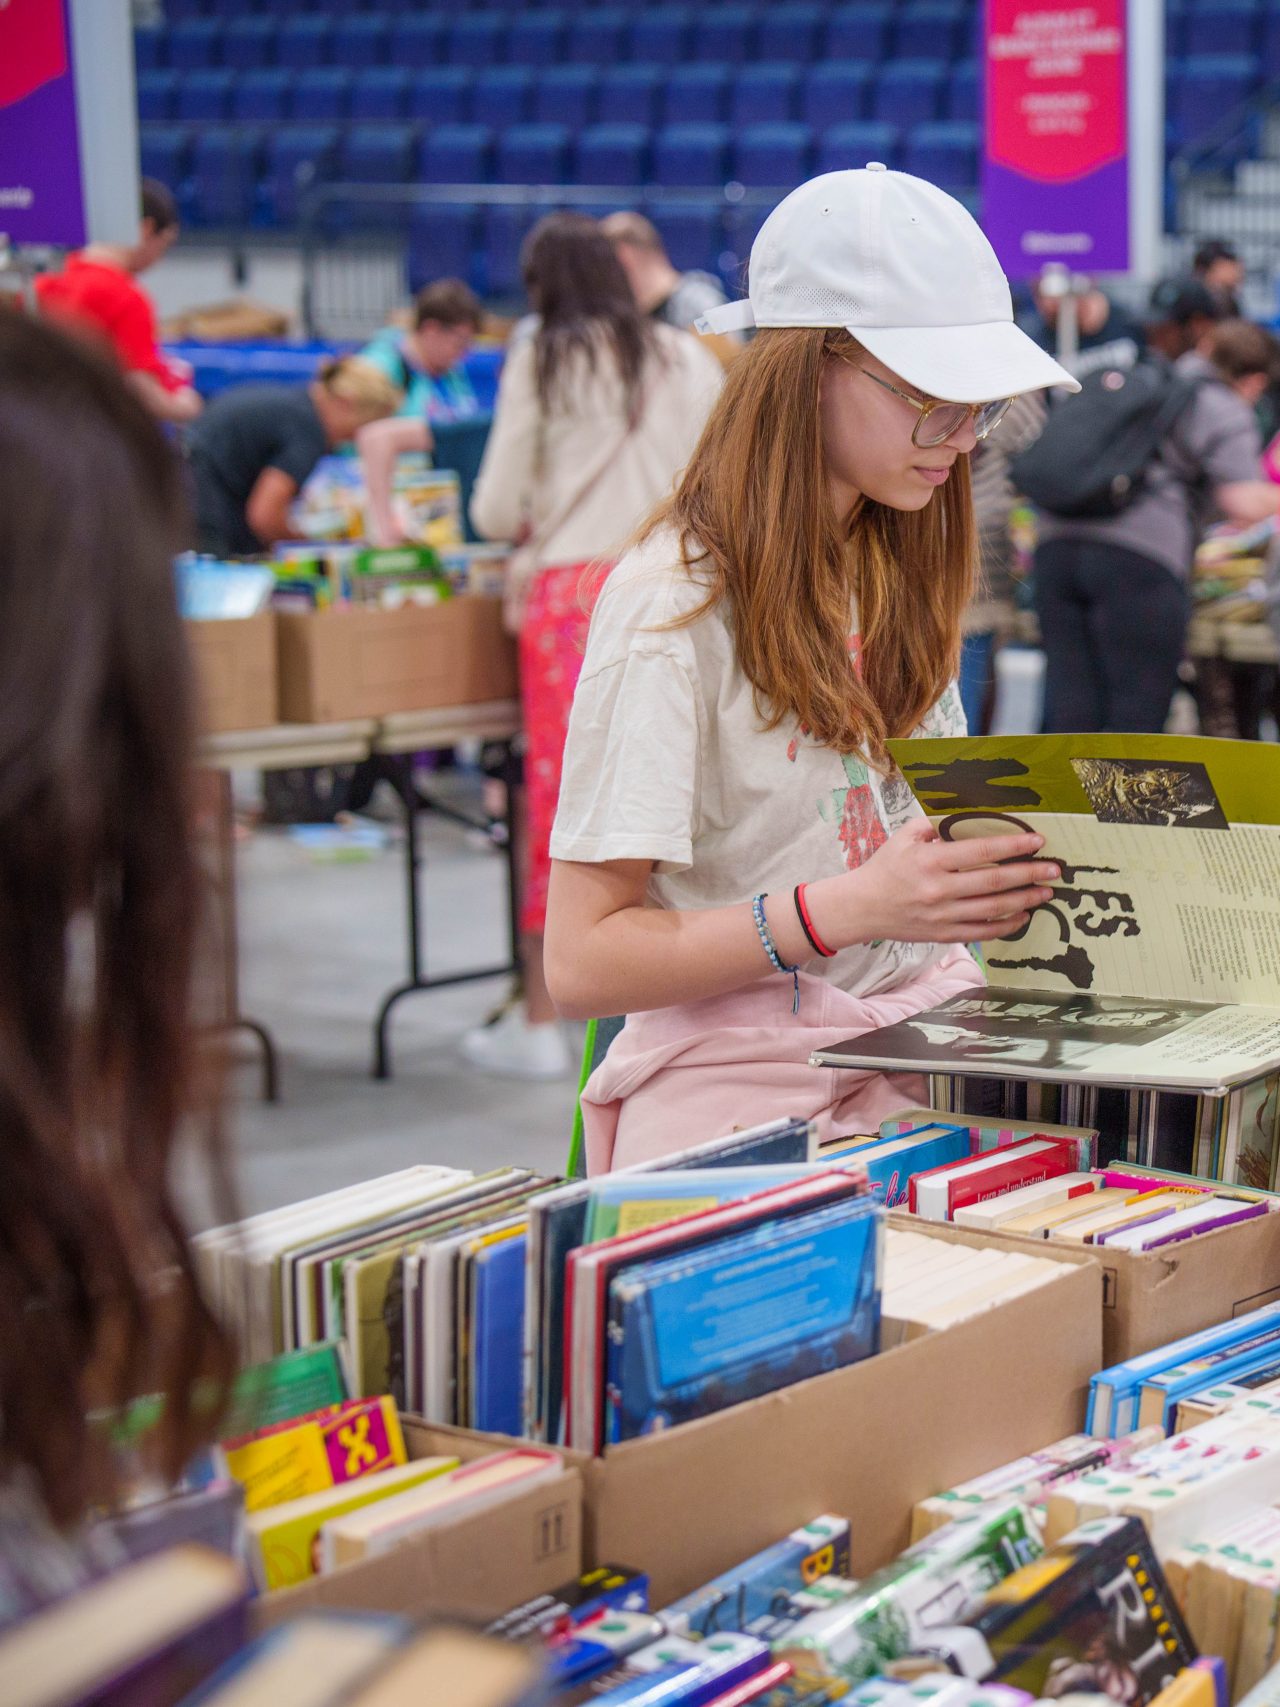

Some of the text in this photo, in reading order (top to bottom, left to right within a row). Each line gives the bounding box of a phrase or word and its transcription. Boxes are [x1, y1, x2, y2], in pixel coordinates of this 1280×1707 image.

[903, 758, 1095, 989] MOST
[977, 1170, 1046, 1203] Learn and understand
